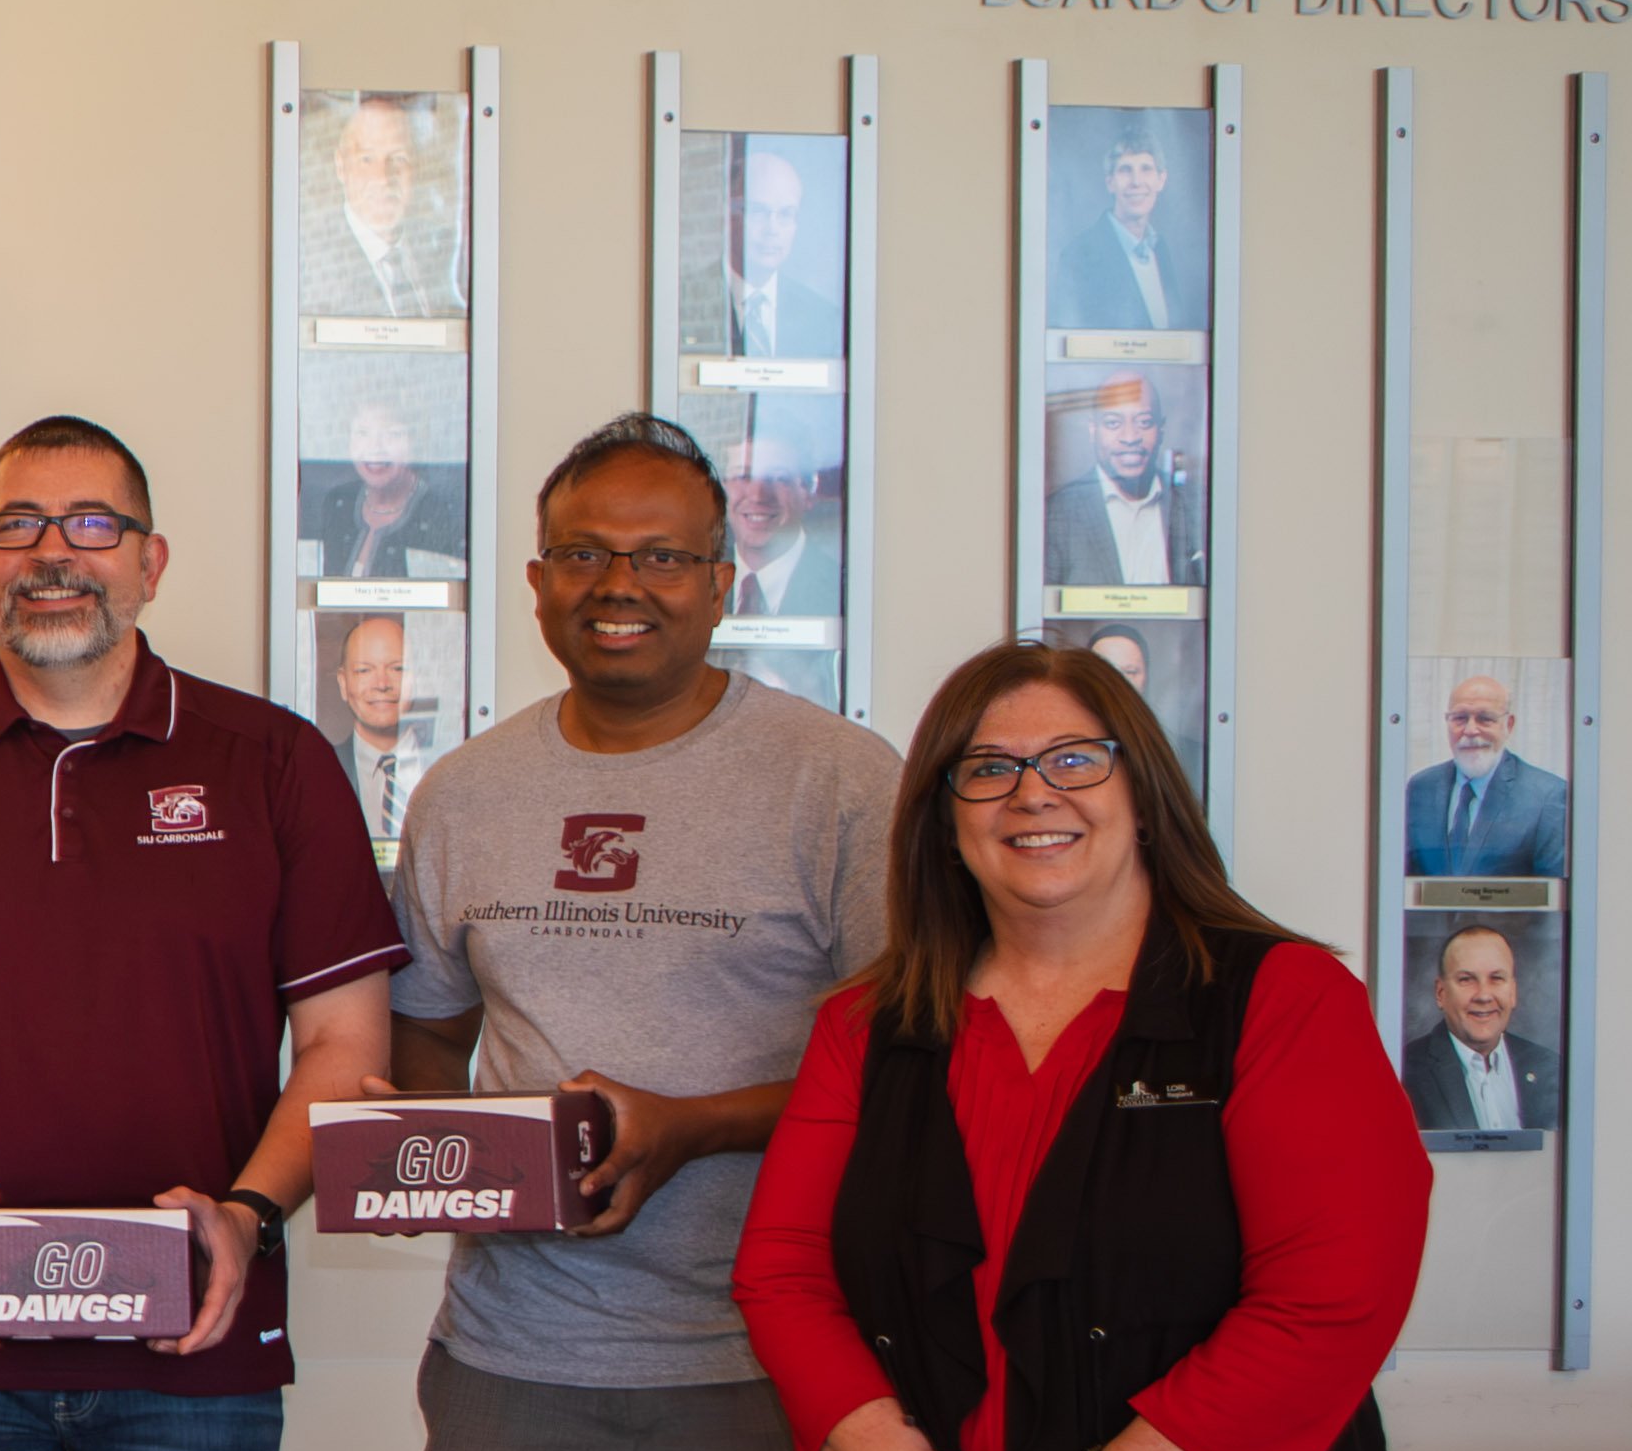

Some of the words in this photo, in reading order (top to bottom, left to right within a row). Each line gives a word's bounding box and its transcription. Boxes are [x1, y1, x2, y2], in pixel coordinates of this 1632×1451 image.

[137, 834, 154, 845] SIU
[156, 830, 225, 844] CARBONDALE
[459, 900, 538, 923] Southern
[544, 900, 619, 924] Illinois
[624, 901, 747, 938] University
[530, 926, 645, 939] CARBONDALE
[396, 1135, 469, 1185] GO
[354, 1188, 515, 1220] DAWGS!
[33, 1241, 105, 1289] GO
